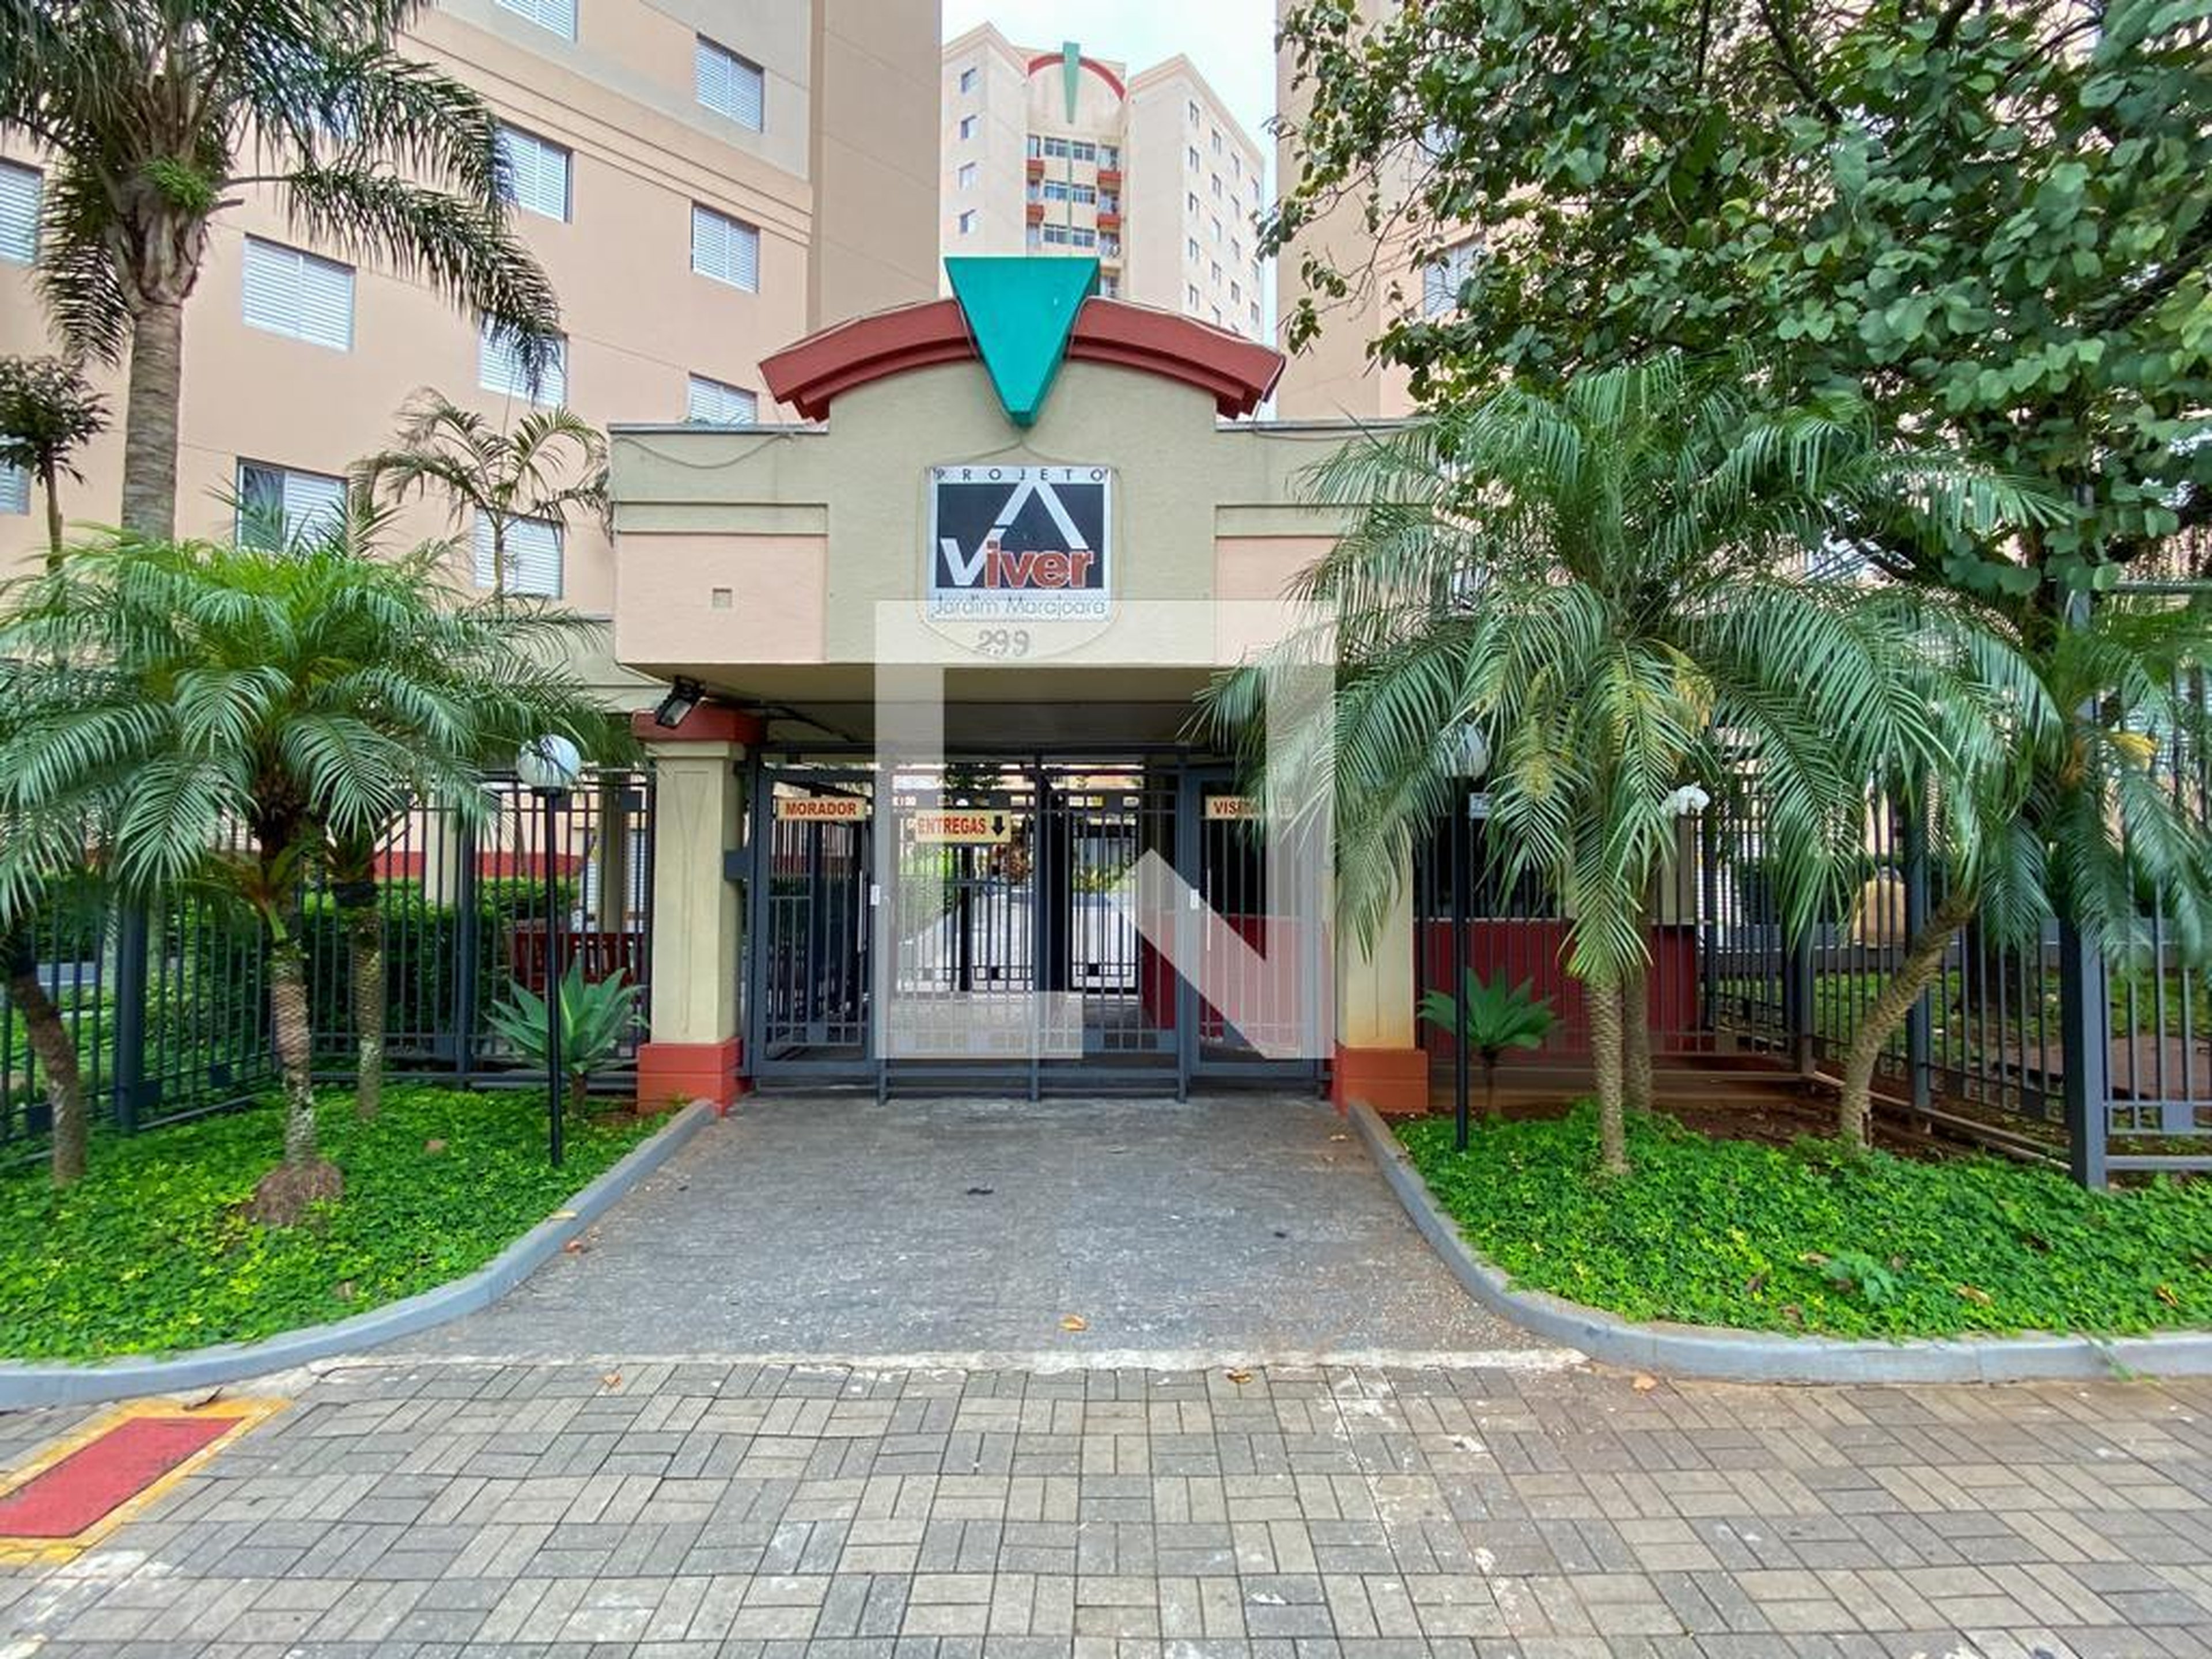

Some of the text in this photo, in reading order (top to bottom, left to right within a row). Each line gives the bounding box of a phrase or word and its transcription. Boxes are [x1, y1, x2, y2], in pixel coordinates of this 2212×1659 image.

[936, 467, 1105, 481] PROJETO
[934, 595, 1107, 617] Jardim Marajoara
[977, 629, 1030, 657] 299
[786, 802, 857, 816] MORADOR
[916, 817, 986, 835] ENTREGAS
